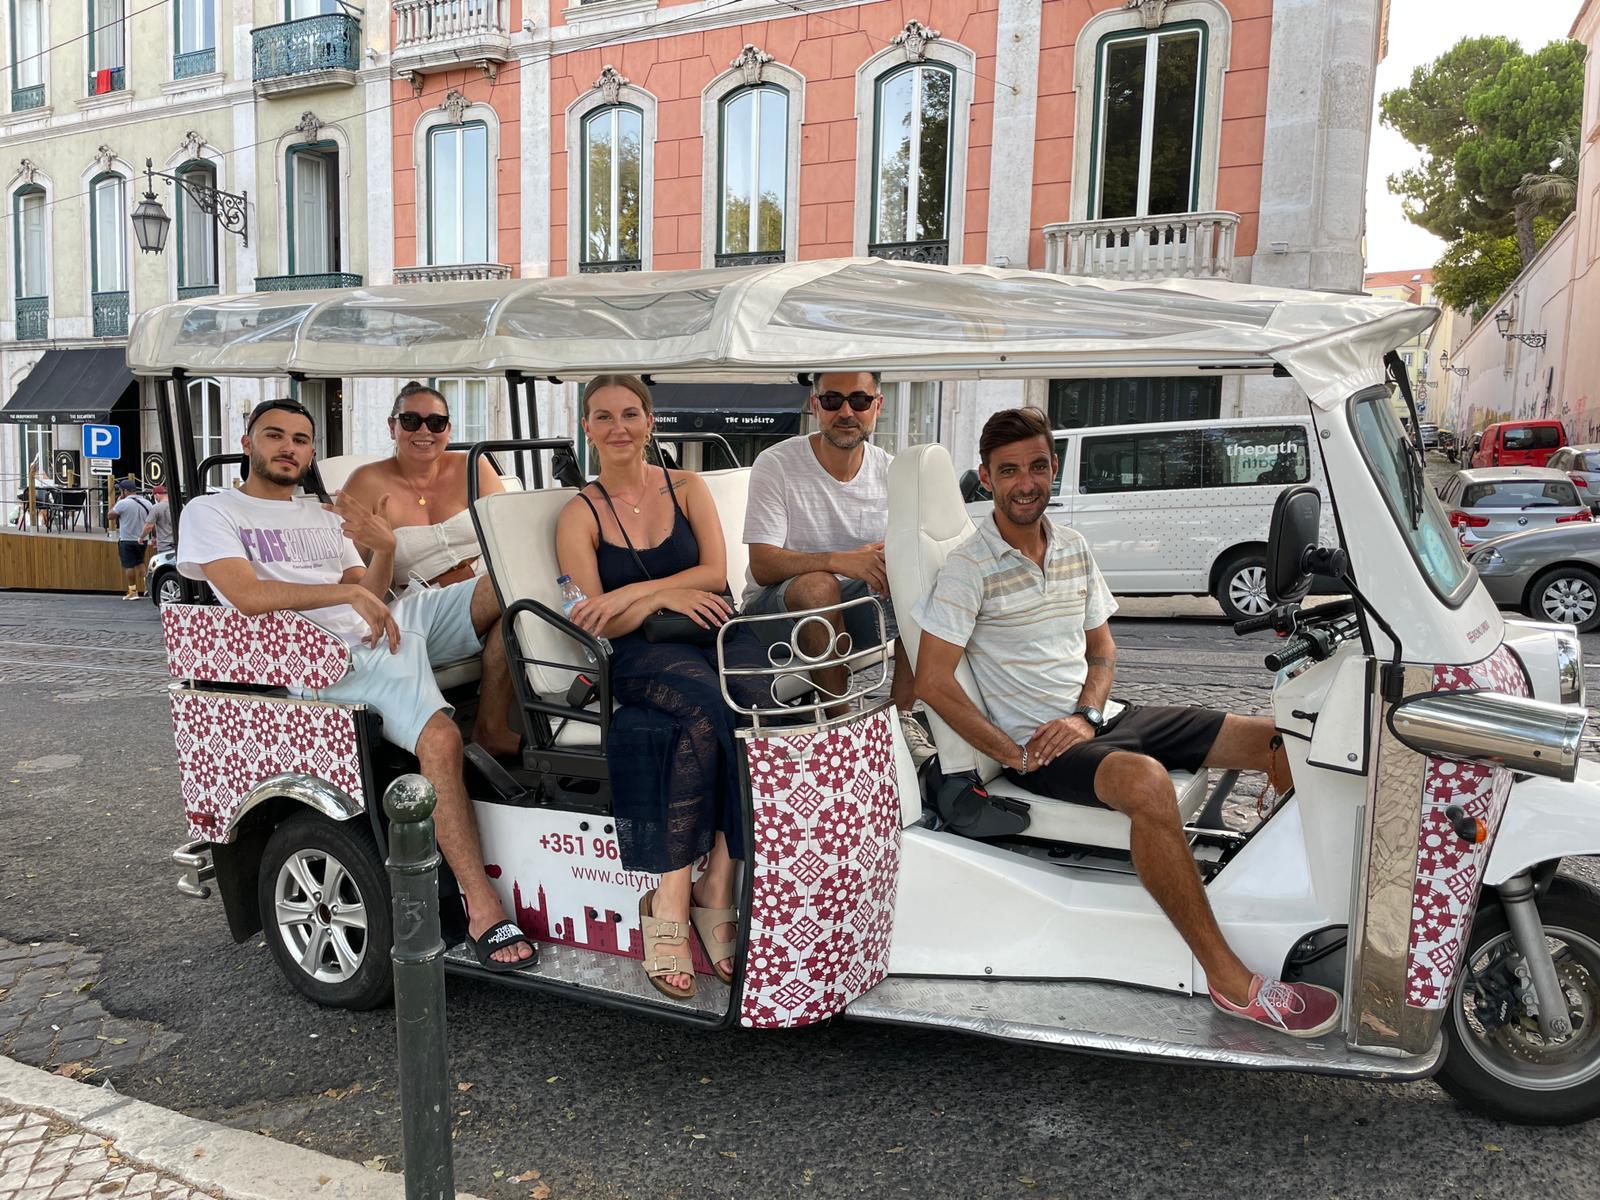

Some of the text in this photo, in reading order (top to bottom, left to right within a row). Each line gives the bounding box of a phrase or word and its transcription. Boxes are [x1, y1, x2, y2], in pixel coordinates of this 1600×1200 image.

[742, 415, 775, 424] INSÓLITO
[91, 428, 112, 455] P
[1226, 440, 1298, 457] thepath
[151, 461, 161, 480] D
[539, 833, 585, 856] +351
[592, 837, 621, 861] 96
[571, 866, 663, 893] www.citytu
